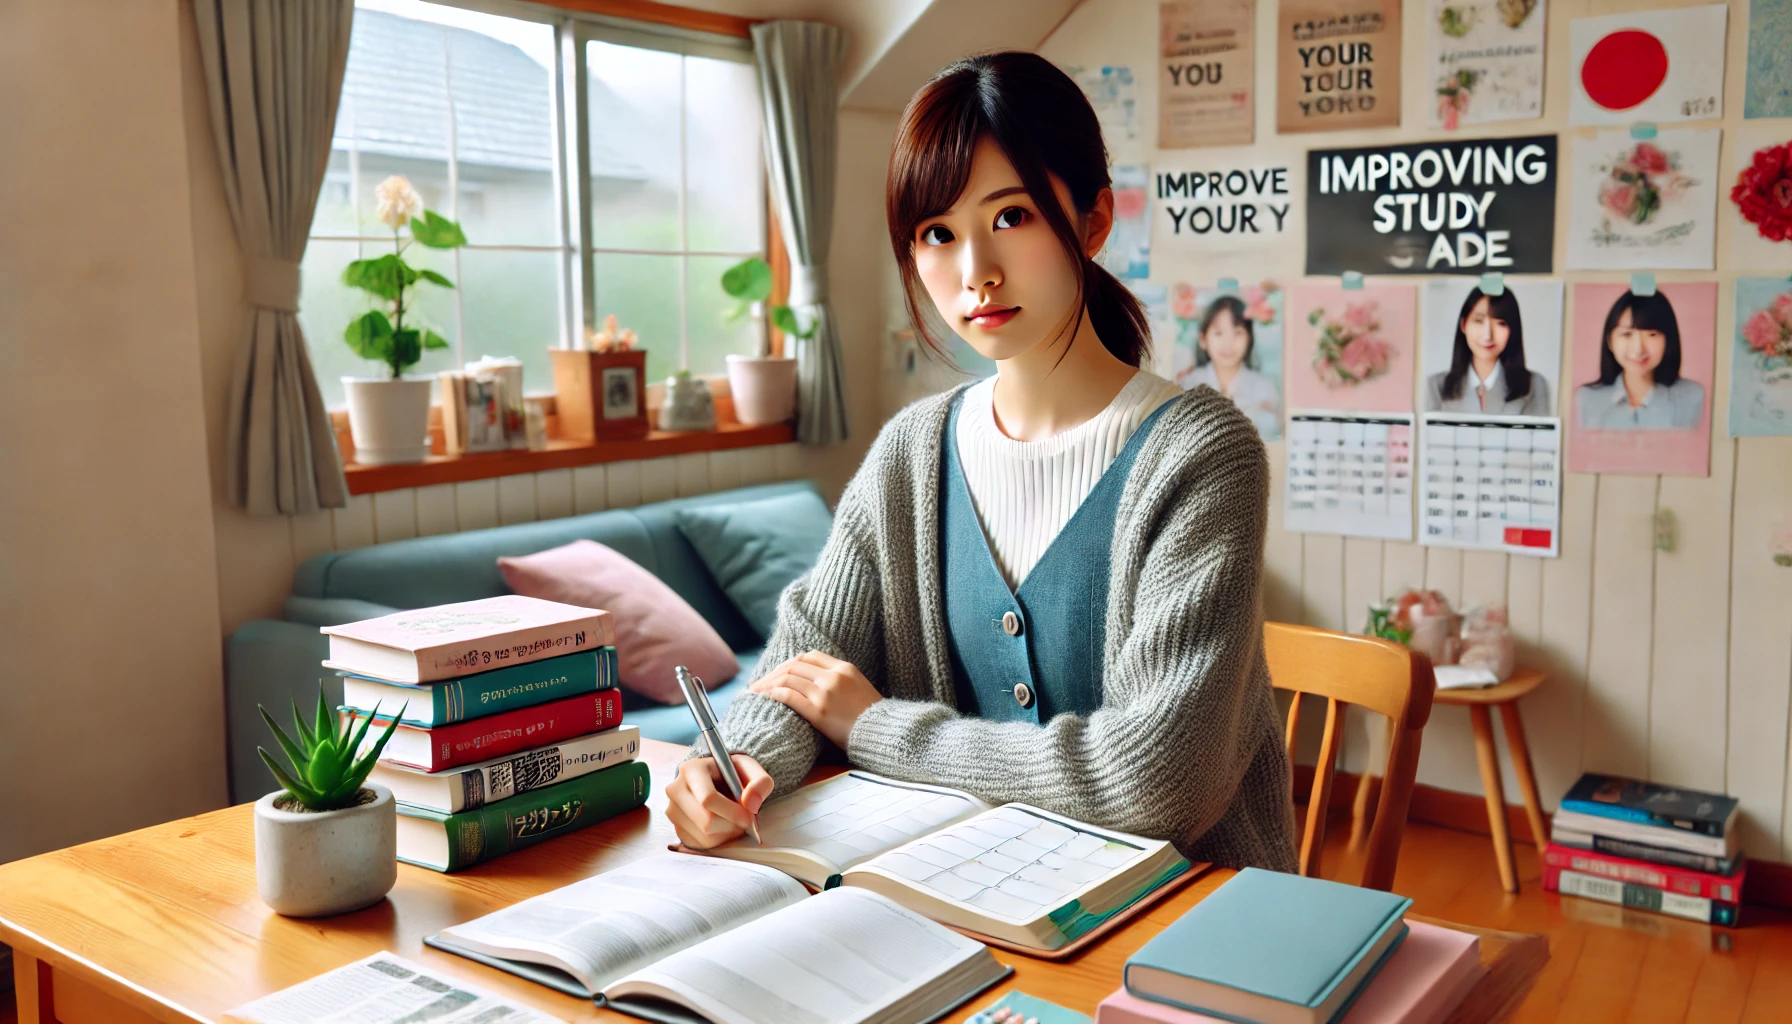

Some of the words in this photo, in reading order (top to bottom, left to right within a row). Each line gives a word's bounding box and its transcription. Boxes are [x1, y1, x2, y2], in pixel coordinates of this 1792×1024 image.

[1298, 42, 1373, 68] YOUR
[1168, 62, 1223, 87] YOU
[1157, 168, 1289, 199] IMPROVE
[1319, 144, 1548, 194] IMPROVING
[1166, 204, 1260, 235] YOUR
[1269, 203, 1290, 232] Y
[1372, 191, 1496, 234] STUDY
[1426, 230, 1514, 269] ADE
